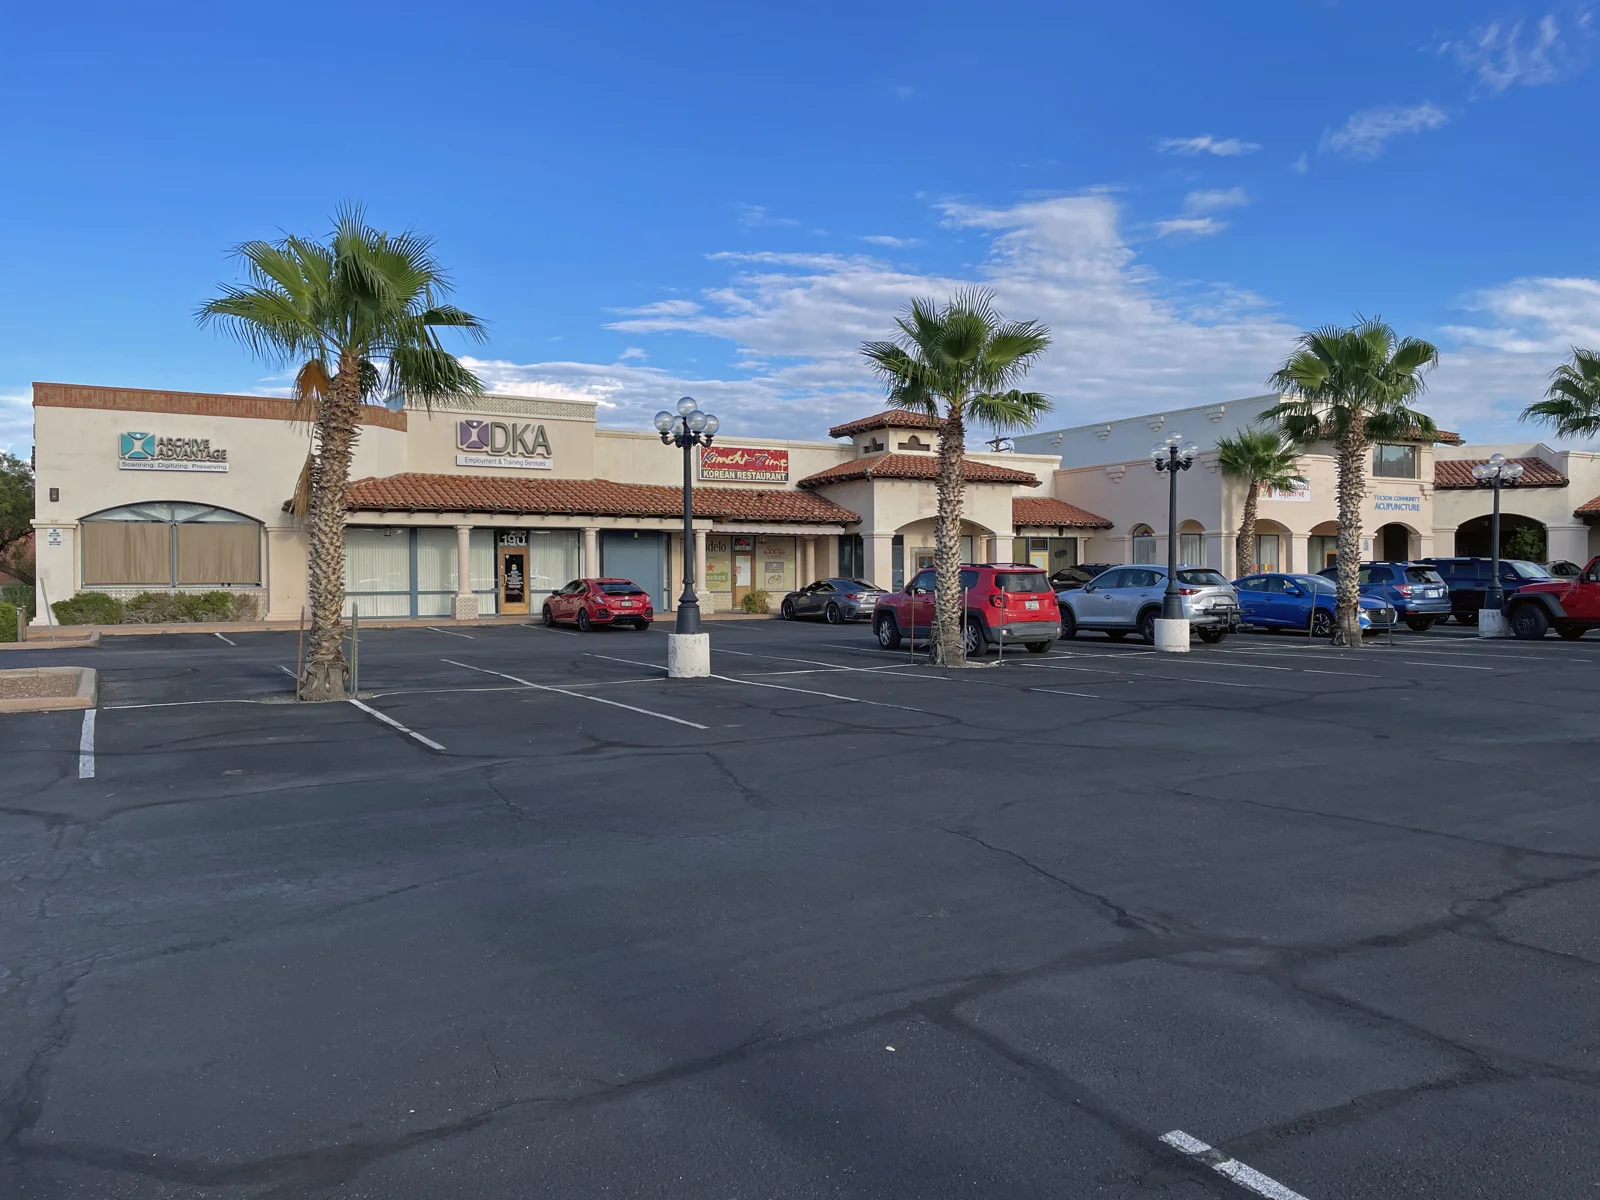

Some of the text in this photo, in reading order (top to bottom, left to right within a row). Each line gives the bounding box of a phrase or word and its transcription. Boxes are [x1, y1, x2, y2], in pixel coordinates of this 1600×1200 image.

[157, 437, 210, 449] ARCHIVE
[490, 421, 552, 455] DKA
[157, 447, 228, 460] ADVANTAGE
[157, 462, 188, 470] Digitizing
[464, 456, 498, 465] Employment
[503, 459, 523, 467] Training
[524, 459, 546, 467] Services
[703, 470, 786, 481] KOREAN RESTAURANT
[1374, 502, 1421, 512] ACUPUNCTURE
[705, 540, 727, 552] delo
